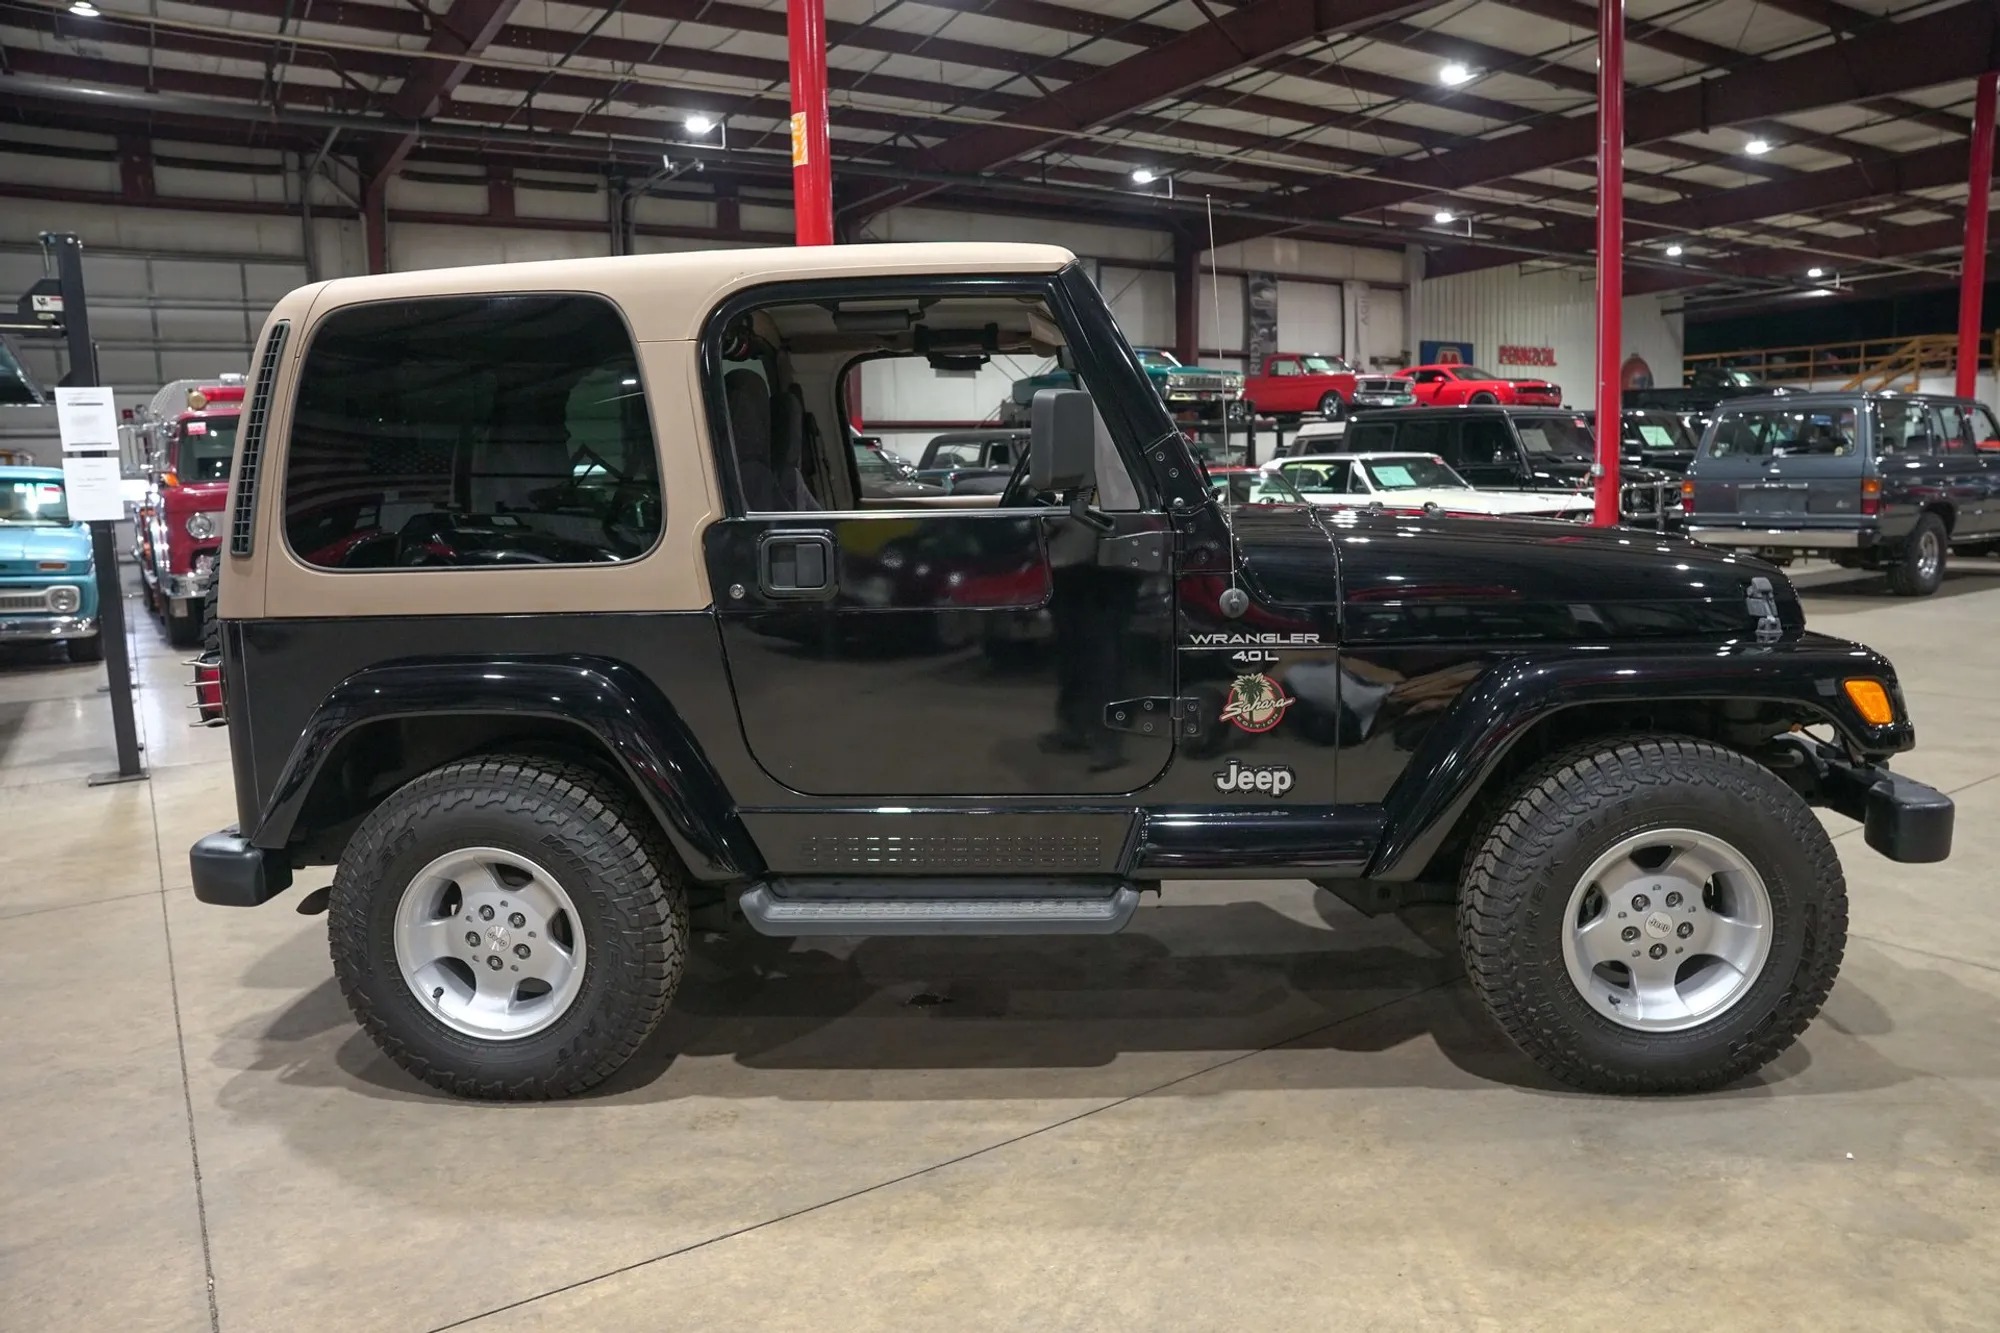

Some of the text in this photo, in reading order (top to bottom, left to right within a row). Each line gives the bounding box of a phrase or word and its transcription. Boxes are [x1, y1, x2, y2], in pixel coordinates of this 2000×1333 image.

[1190, 633, 1320, 644] WRANGLER
[1221, 696, 1293, 720] Sahara
[1236, 713, 1278, 728] EDITION
[1216, 763, 1292, 795] Jeep
